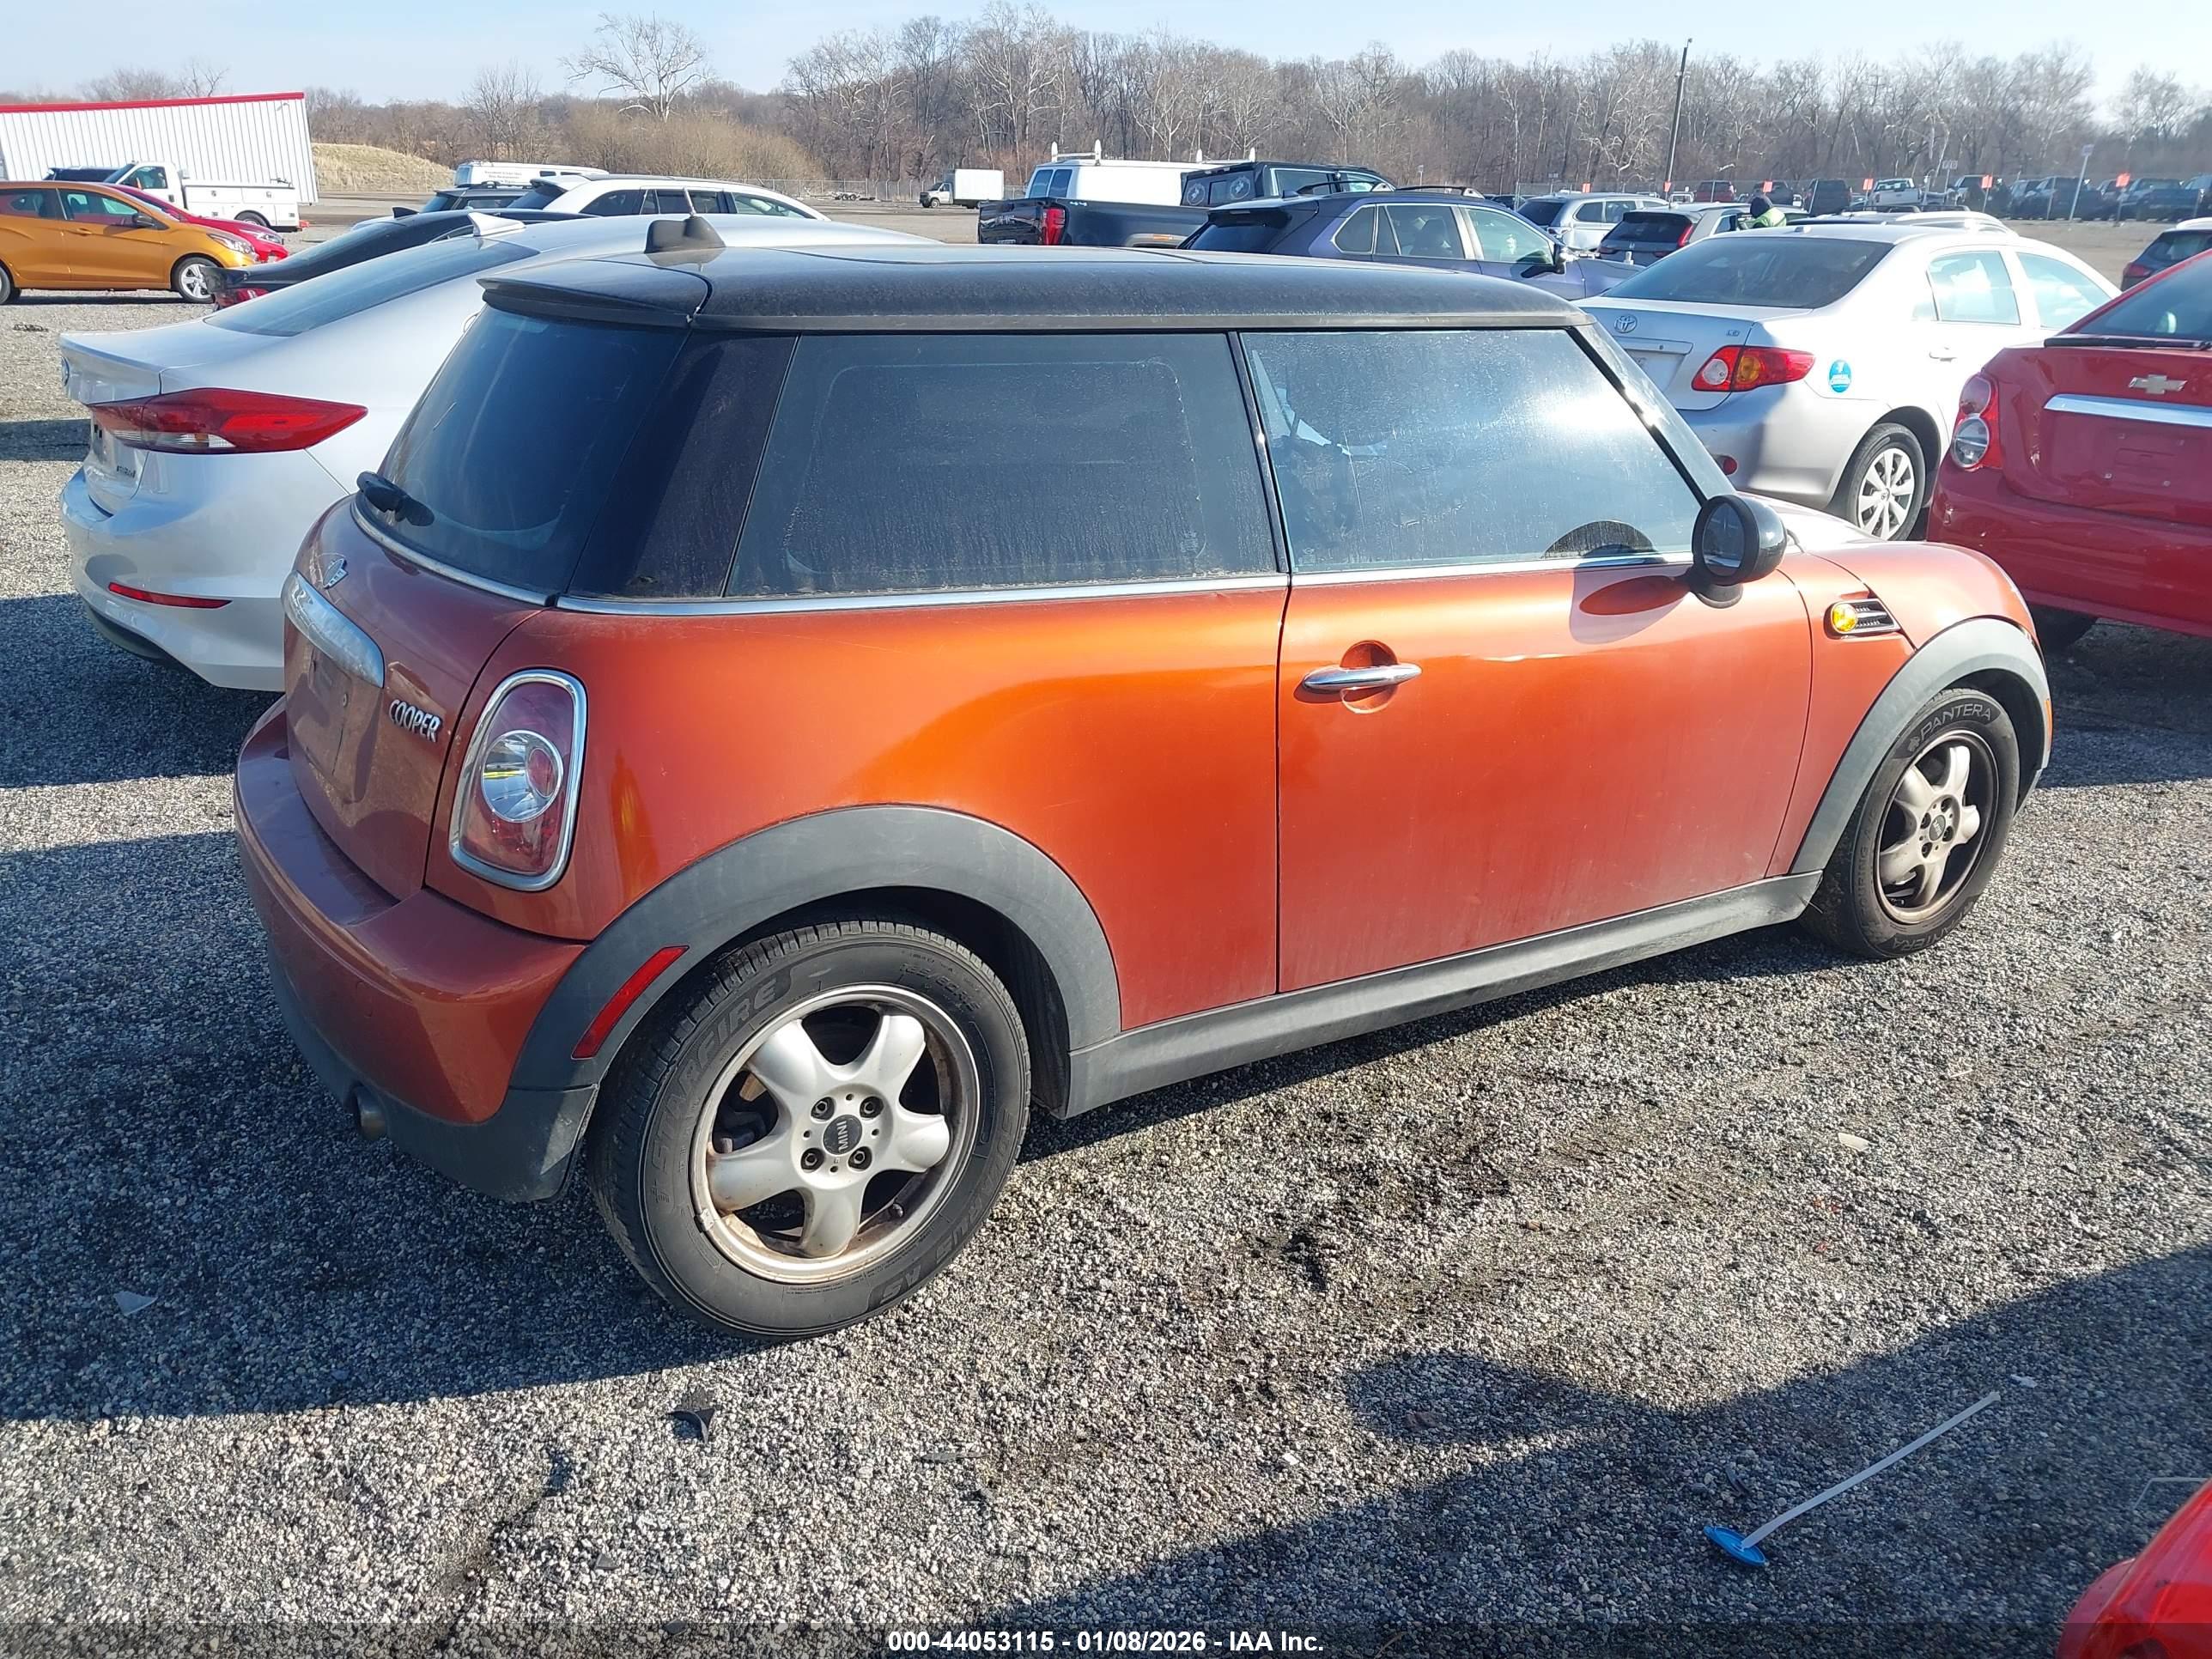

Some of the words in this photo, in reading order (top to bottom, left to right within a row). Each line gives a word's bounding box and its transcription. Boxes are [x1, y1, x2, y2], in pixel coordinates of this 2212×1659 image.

[389, 699, 441, 743] COOPER
[1920, 703, 1991, 741] PANTERA
[653, 977, 777, 1170] STARFIRE
[836, 1120, 849, 1152] MINI
